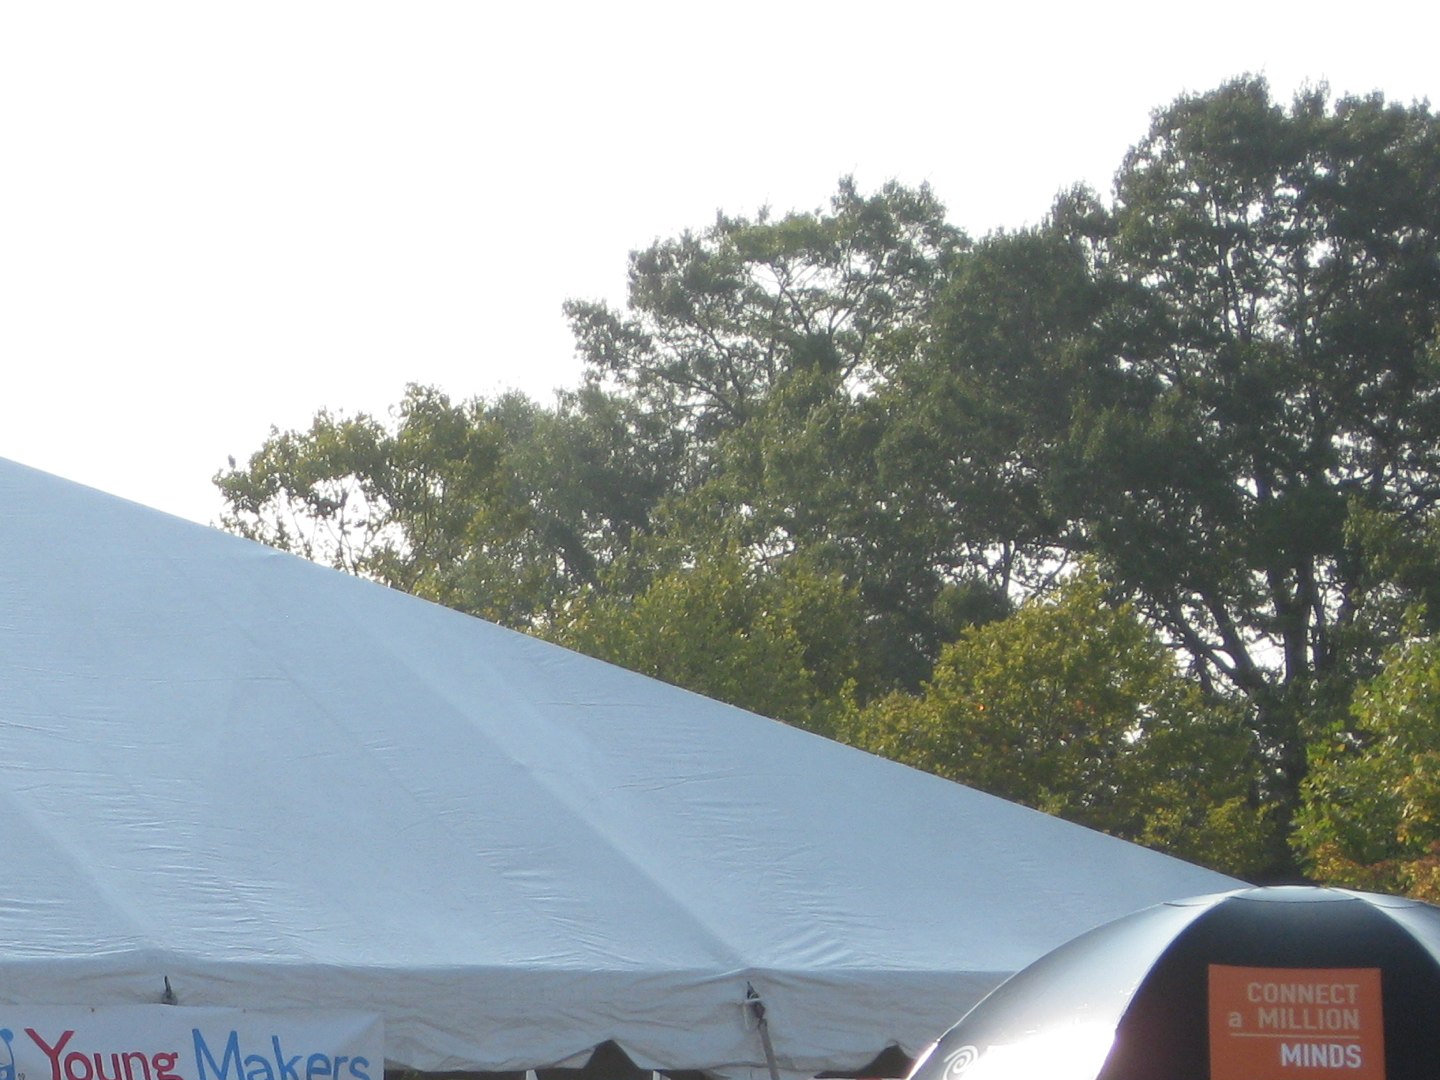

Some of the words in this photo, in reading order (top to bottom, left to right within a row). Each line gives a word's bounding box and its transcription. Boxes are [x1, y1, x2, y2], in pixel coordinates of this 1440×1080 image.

[1247, 982, 1360, 1005] CONNECT
[1228, 1011, 1243, 1028] a
[1258, 1007, 1360, 1030] MILLION
[1280, 1043, 1362, 1068] MINDS
